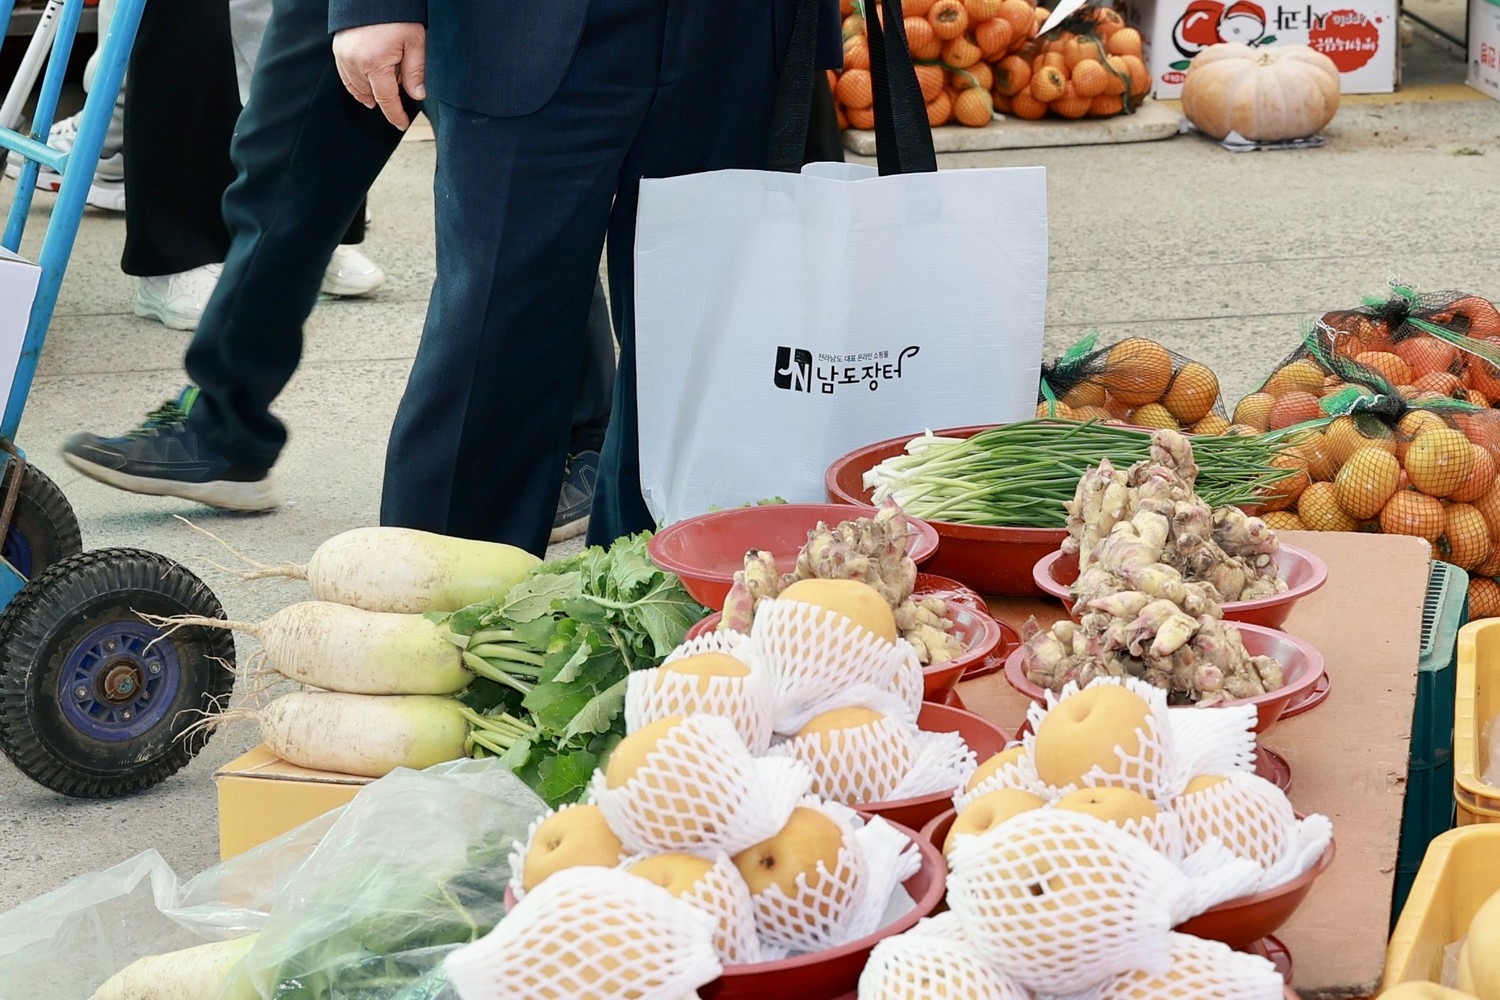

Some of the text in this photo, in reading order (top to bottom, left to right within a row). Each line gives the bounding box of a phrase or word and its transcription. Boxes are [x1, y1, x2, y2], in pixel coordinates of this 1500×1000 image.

[1272, 4, 1332, 31] 사과
[816, 345, 920, 394] 남도장터
[818, 353, 842, 363] 전라남도
[844, 354, 857, 363] 대표
[857, 353, 873, 362] 온라인
